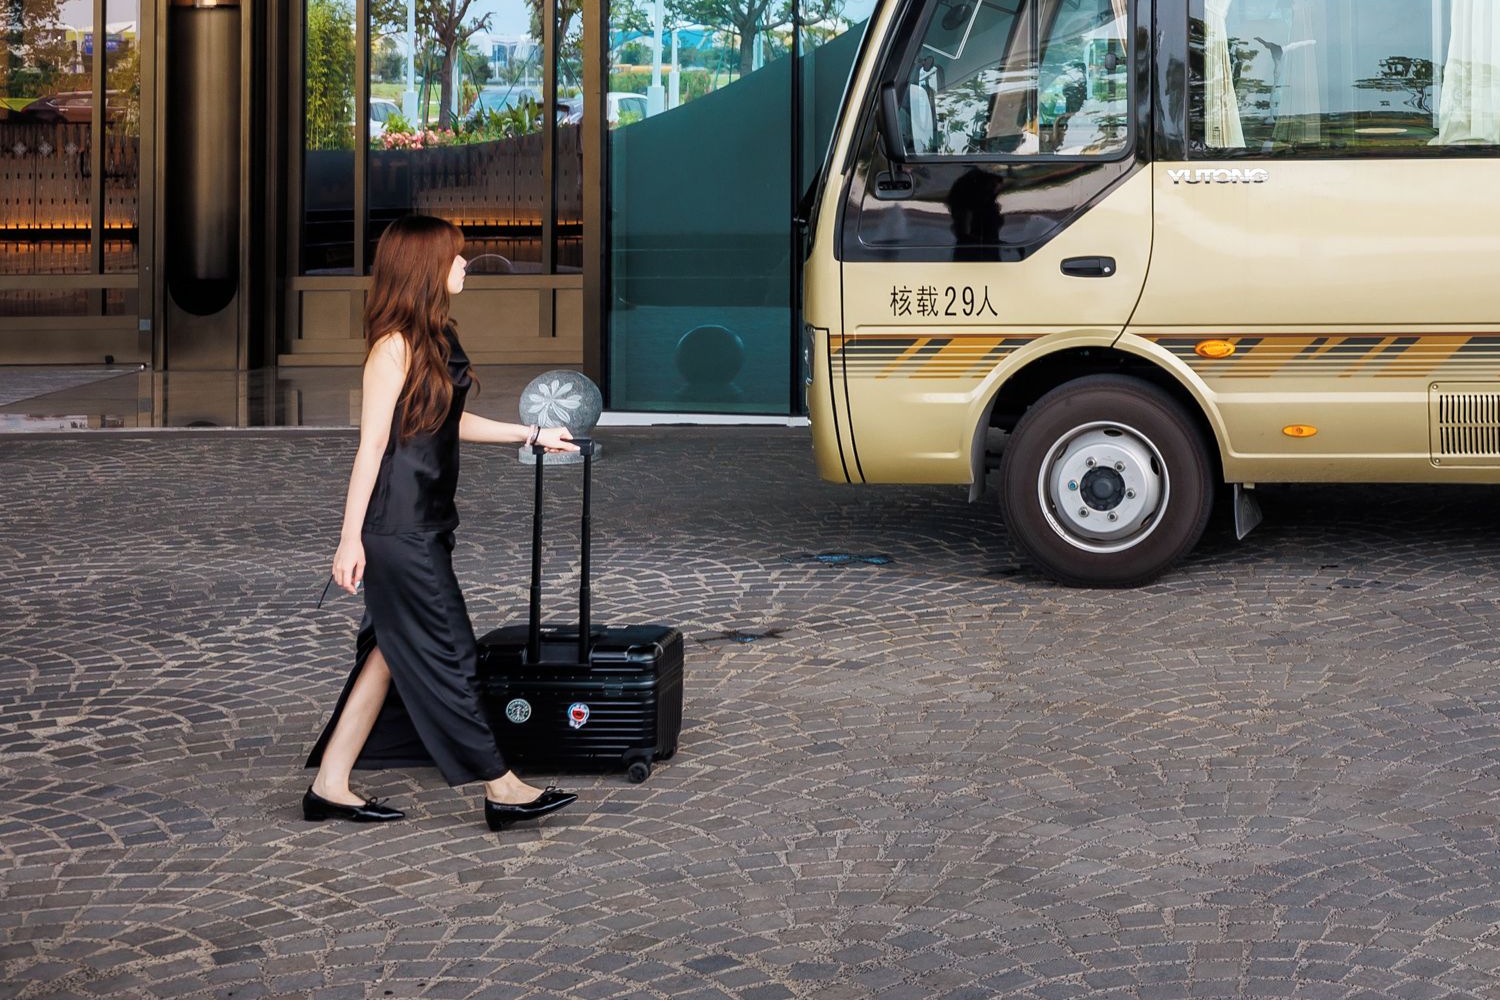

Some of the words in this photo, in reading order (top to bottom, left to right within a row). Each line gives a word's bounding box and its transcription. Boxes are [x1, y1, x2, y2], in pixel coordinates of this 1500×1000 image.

[1167, 168, 1270, 185] YUTONG
[889, 285, 999, 317] 核载29人
